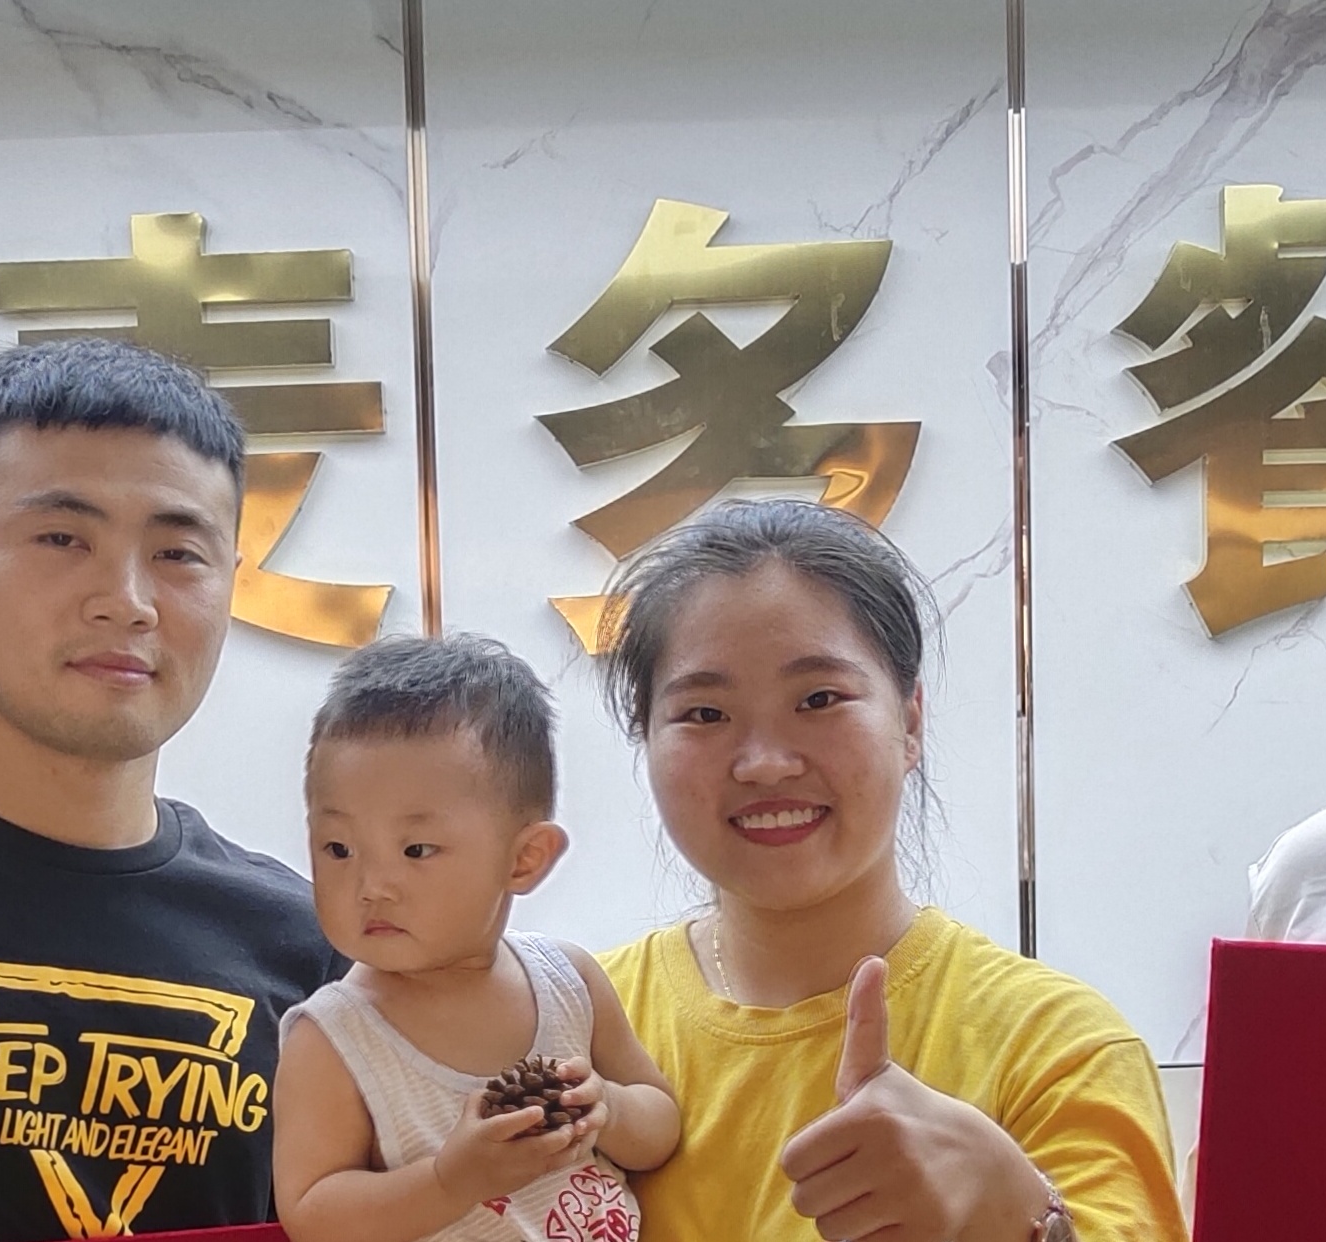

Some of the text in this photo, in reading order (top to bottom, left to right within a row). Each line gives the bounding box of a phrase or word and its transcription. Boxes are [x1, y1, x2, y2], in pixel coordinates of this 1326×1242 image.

[78, 1032, 269, 1132] TRYING
[0, 1107, 219, 1166] LIGHT AND ELEGANT
